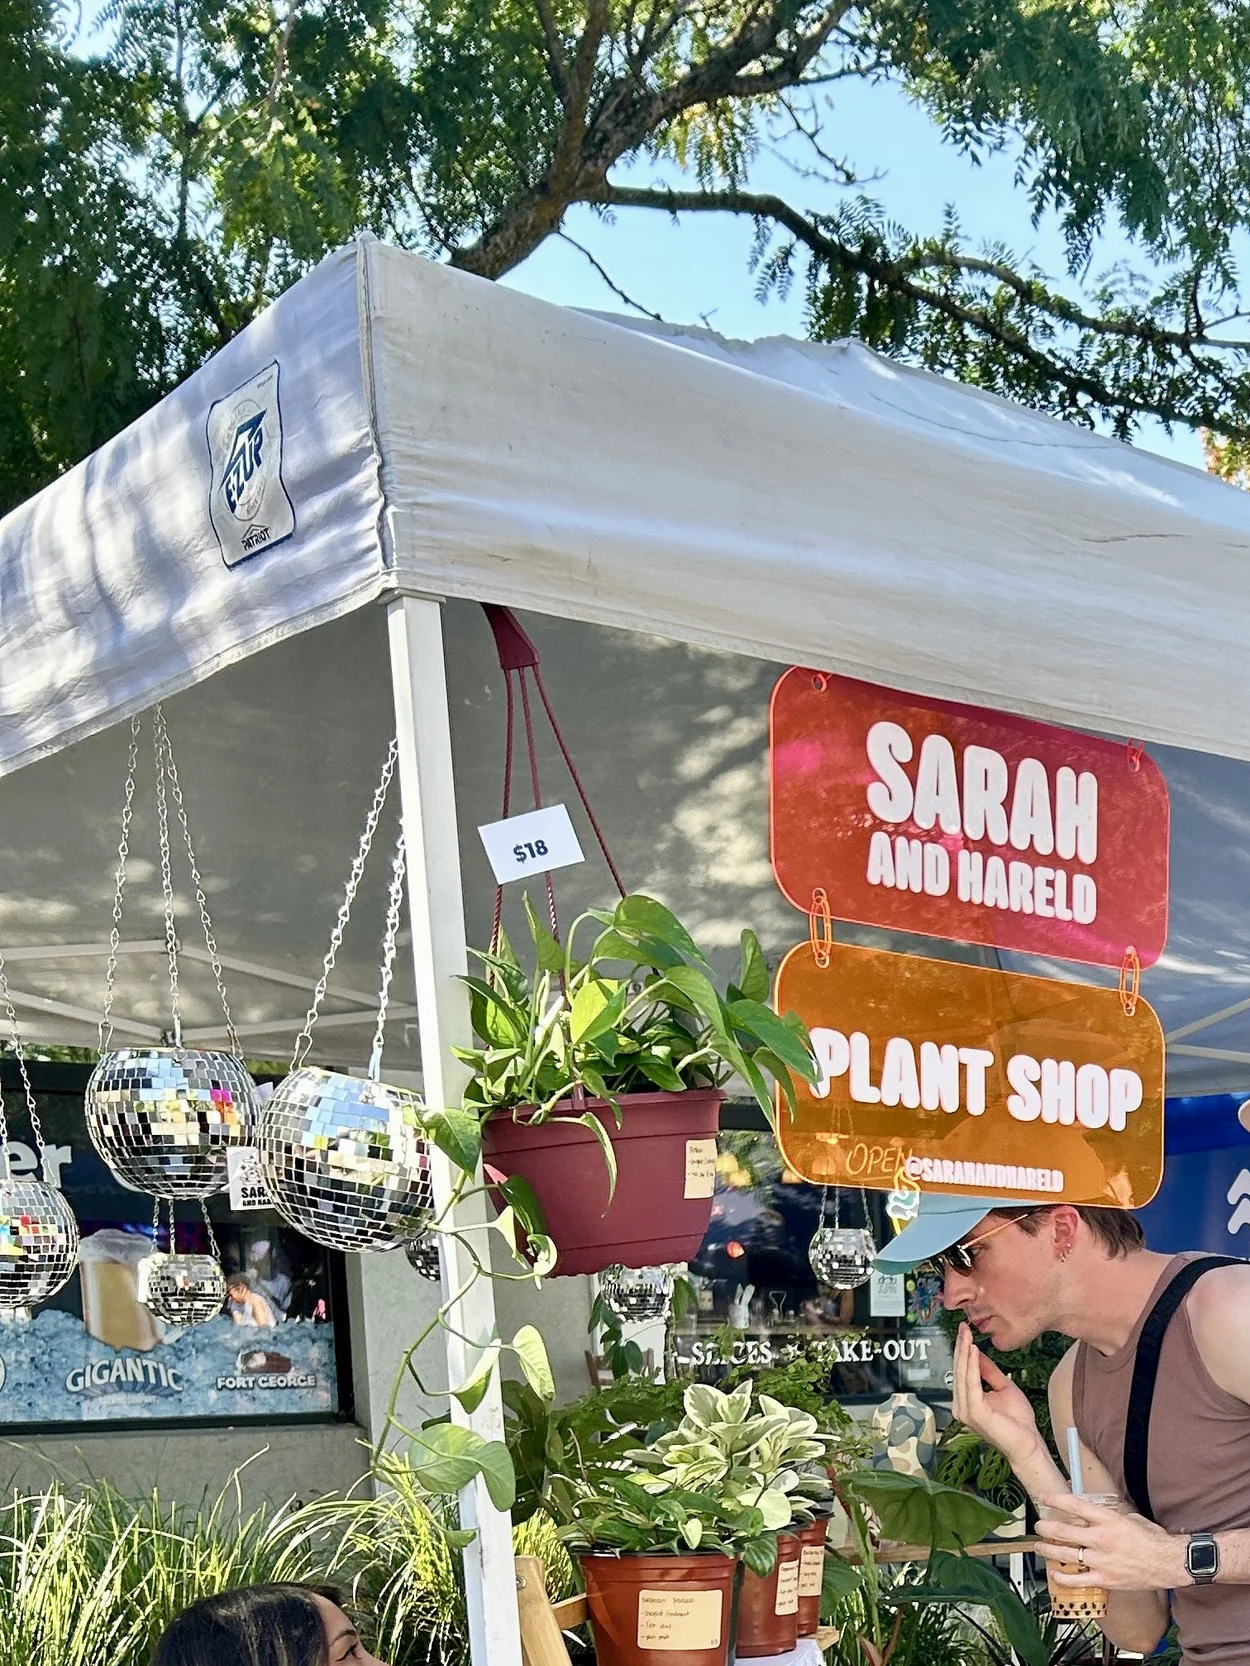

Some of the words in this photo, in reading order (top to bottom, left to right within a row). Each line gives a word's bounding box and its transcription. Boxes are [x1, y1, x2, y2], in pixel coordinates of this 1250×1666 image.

[241, 527, 270, 552] PATRIOT
[866, 721, 1098, 865] SARAH
[512, 839, 549, 864] $18
[867, 832, 950, 898] AND
[958, 849, 1097, 924] HARELD
[808, 1027, 994, 1116] PLANT
[1007, 1054, 1143, 1131] SHOP
[846, 1142, 913, 1176] OPEN
[904, 1156, 1064, 1193] @SARAHANDHARELD
[241, 1186, 266, 1199] SAR
[691, 1340, 773, 1366] SLCES
[65, 1357, 184, 1392] GIGANTIC
[217, 1375, 255, 1390] FORT
[258, 1375, 316, 1389] GEORGE
